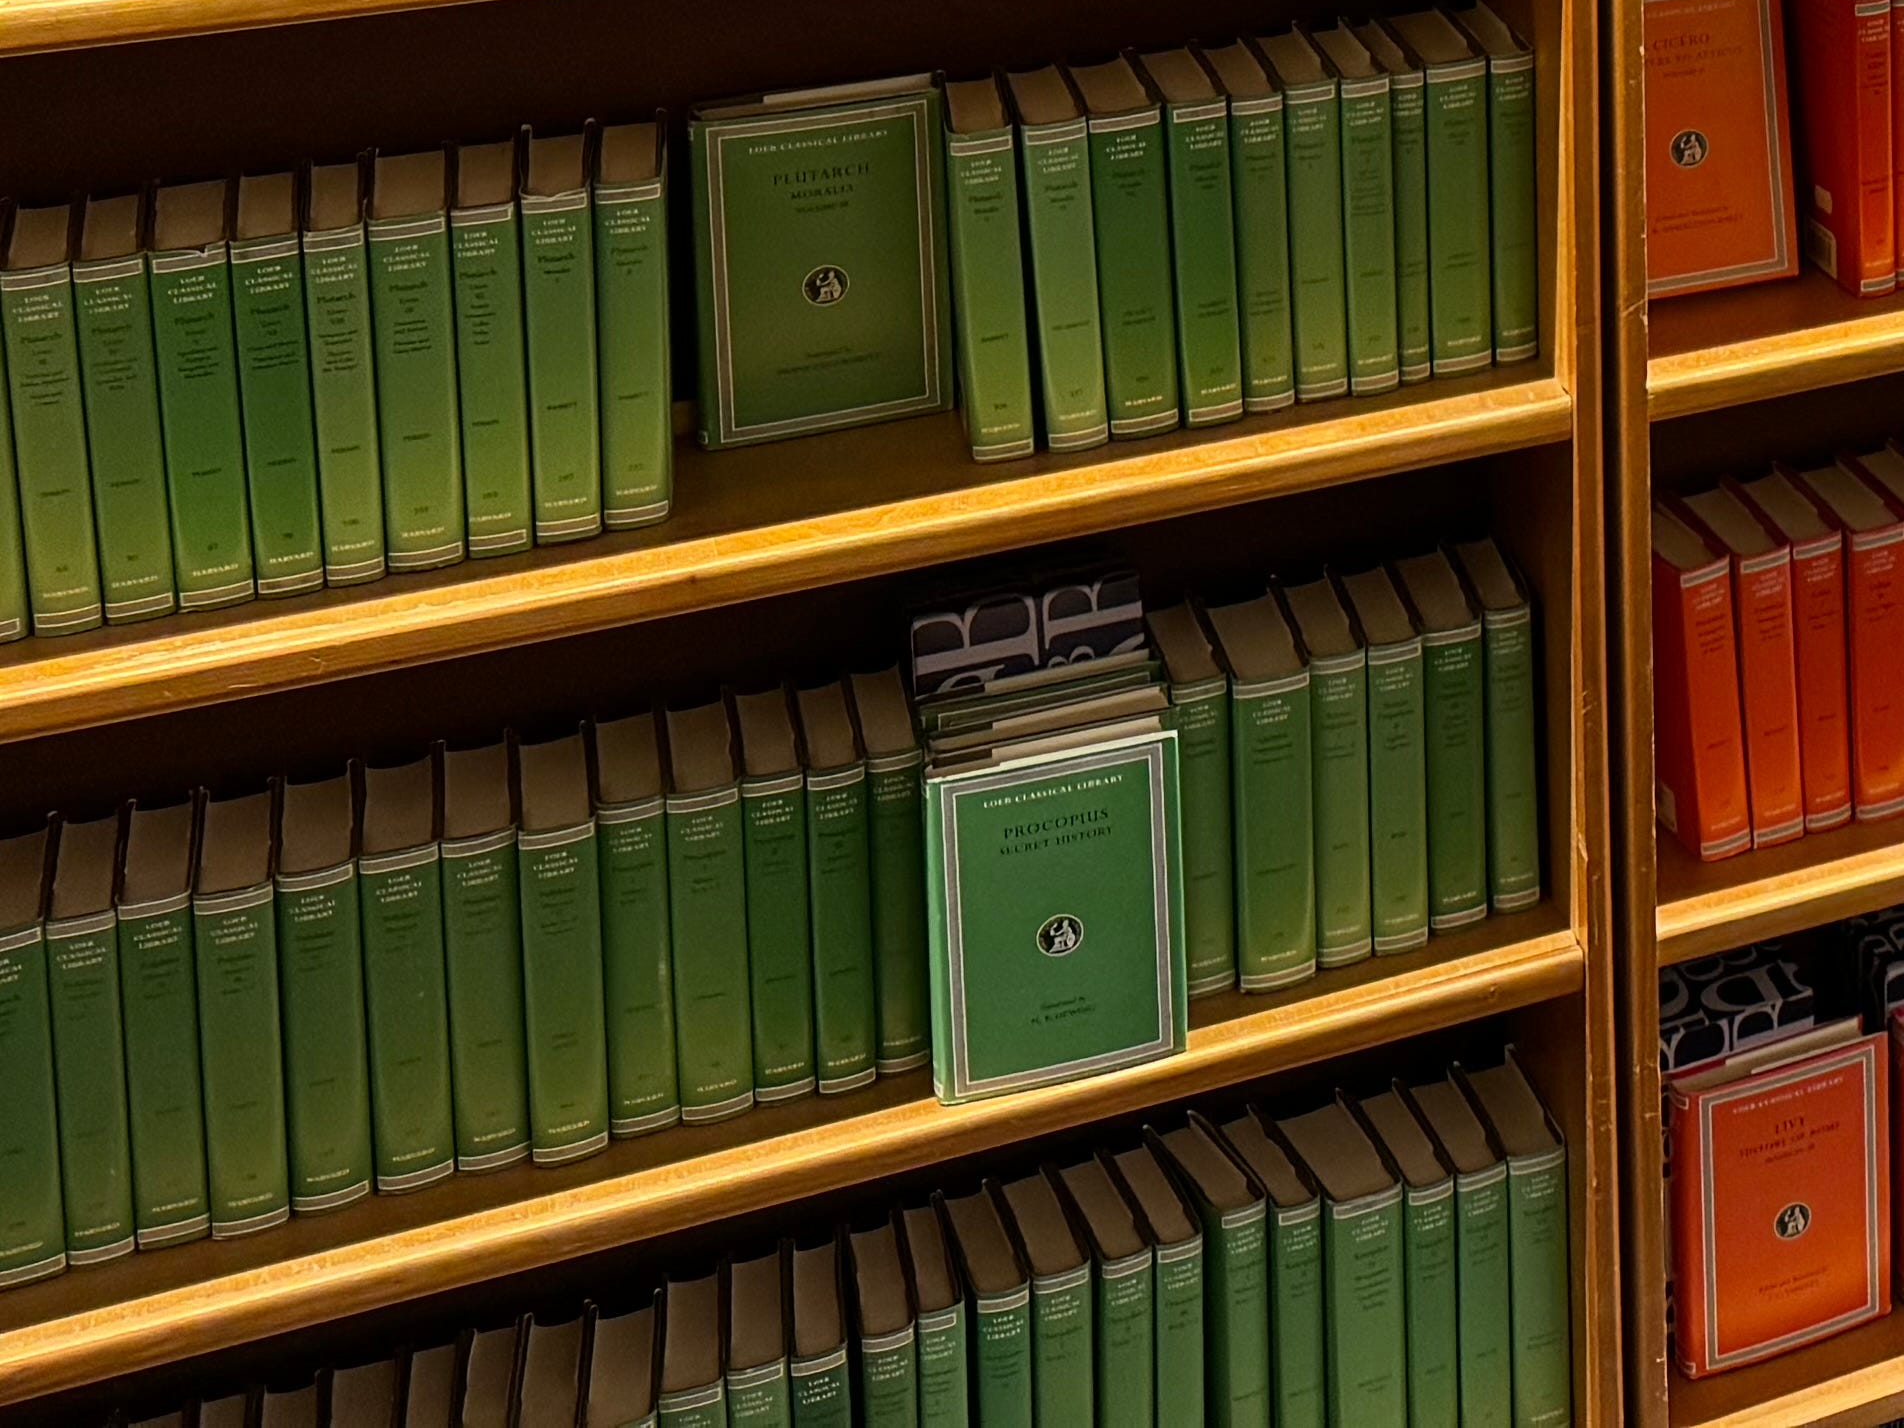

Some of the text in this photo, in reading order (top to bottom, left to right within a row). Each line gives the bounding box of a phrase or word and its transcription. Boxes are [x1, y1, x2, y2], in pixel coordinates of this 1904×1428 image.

[773, 164, 869, 186] PLUTARCH
[983, 775, 1123, 809] LOEB CLASSICAL LIBRARY
[1004, 808, 1108, 840] PROCOPIUS
[1055, 826, 1113, 846] HISTORY
